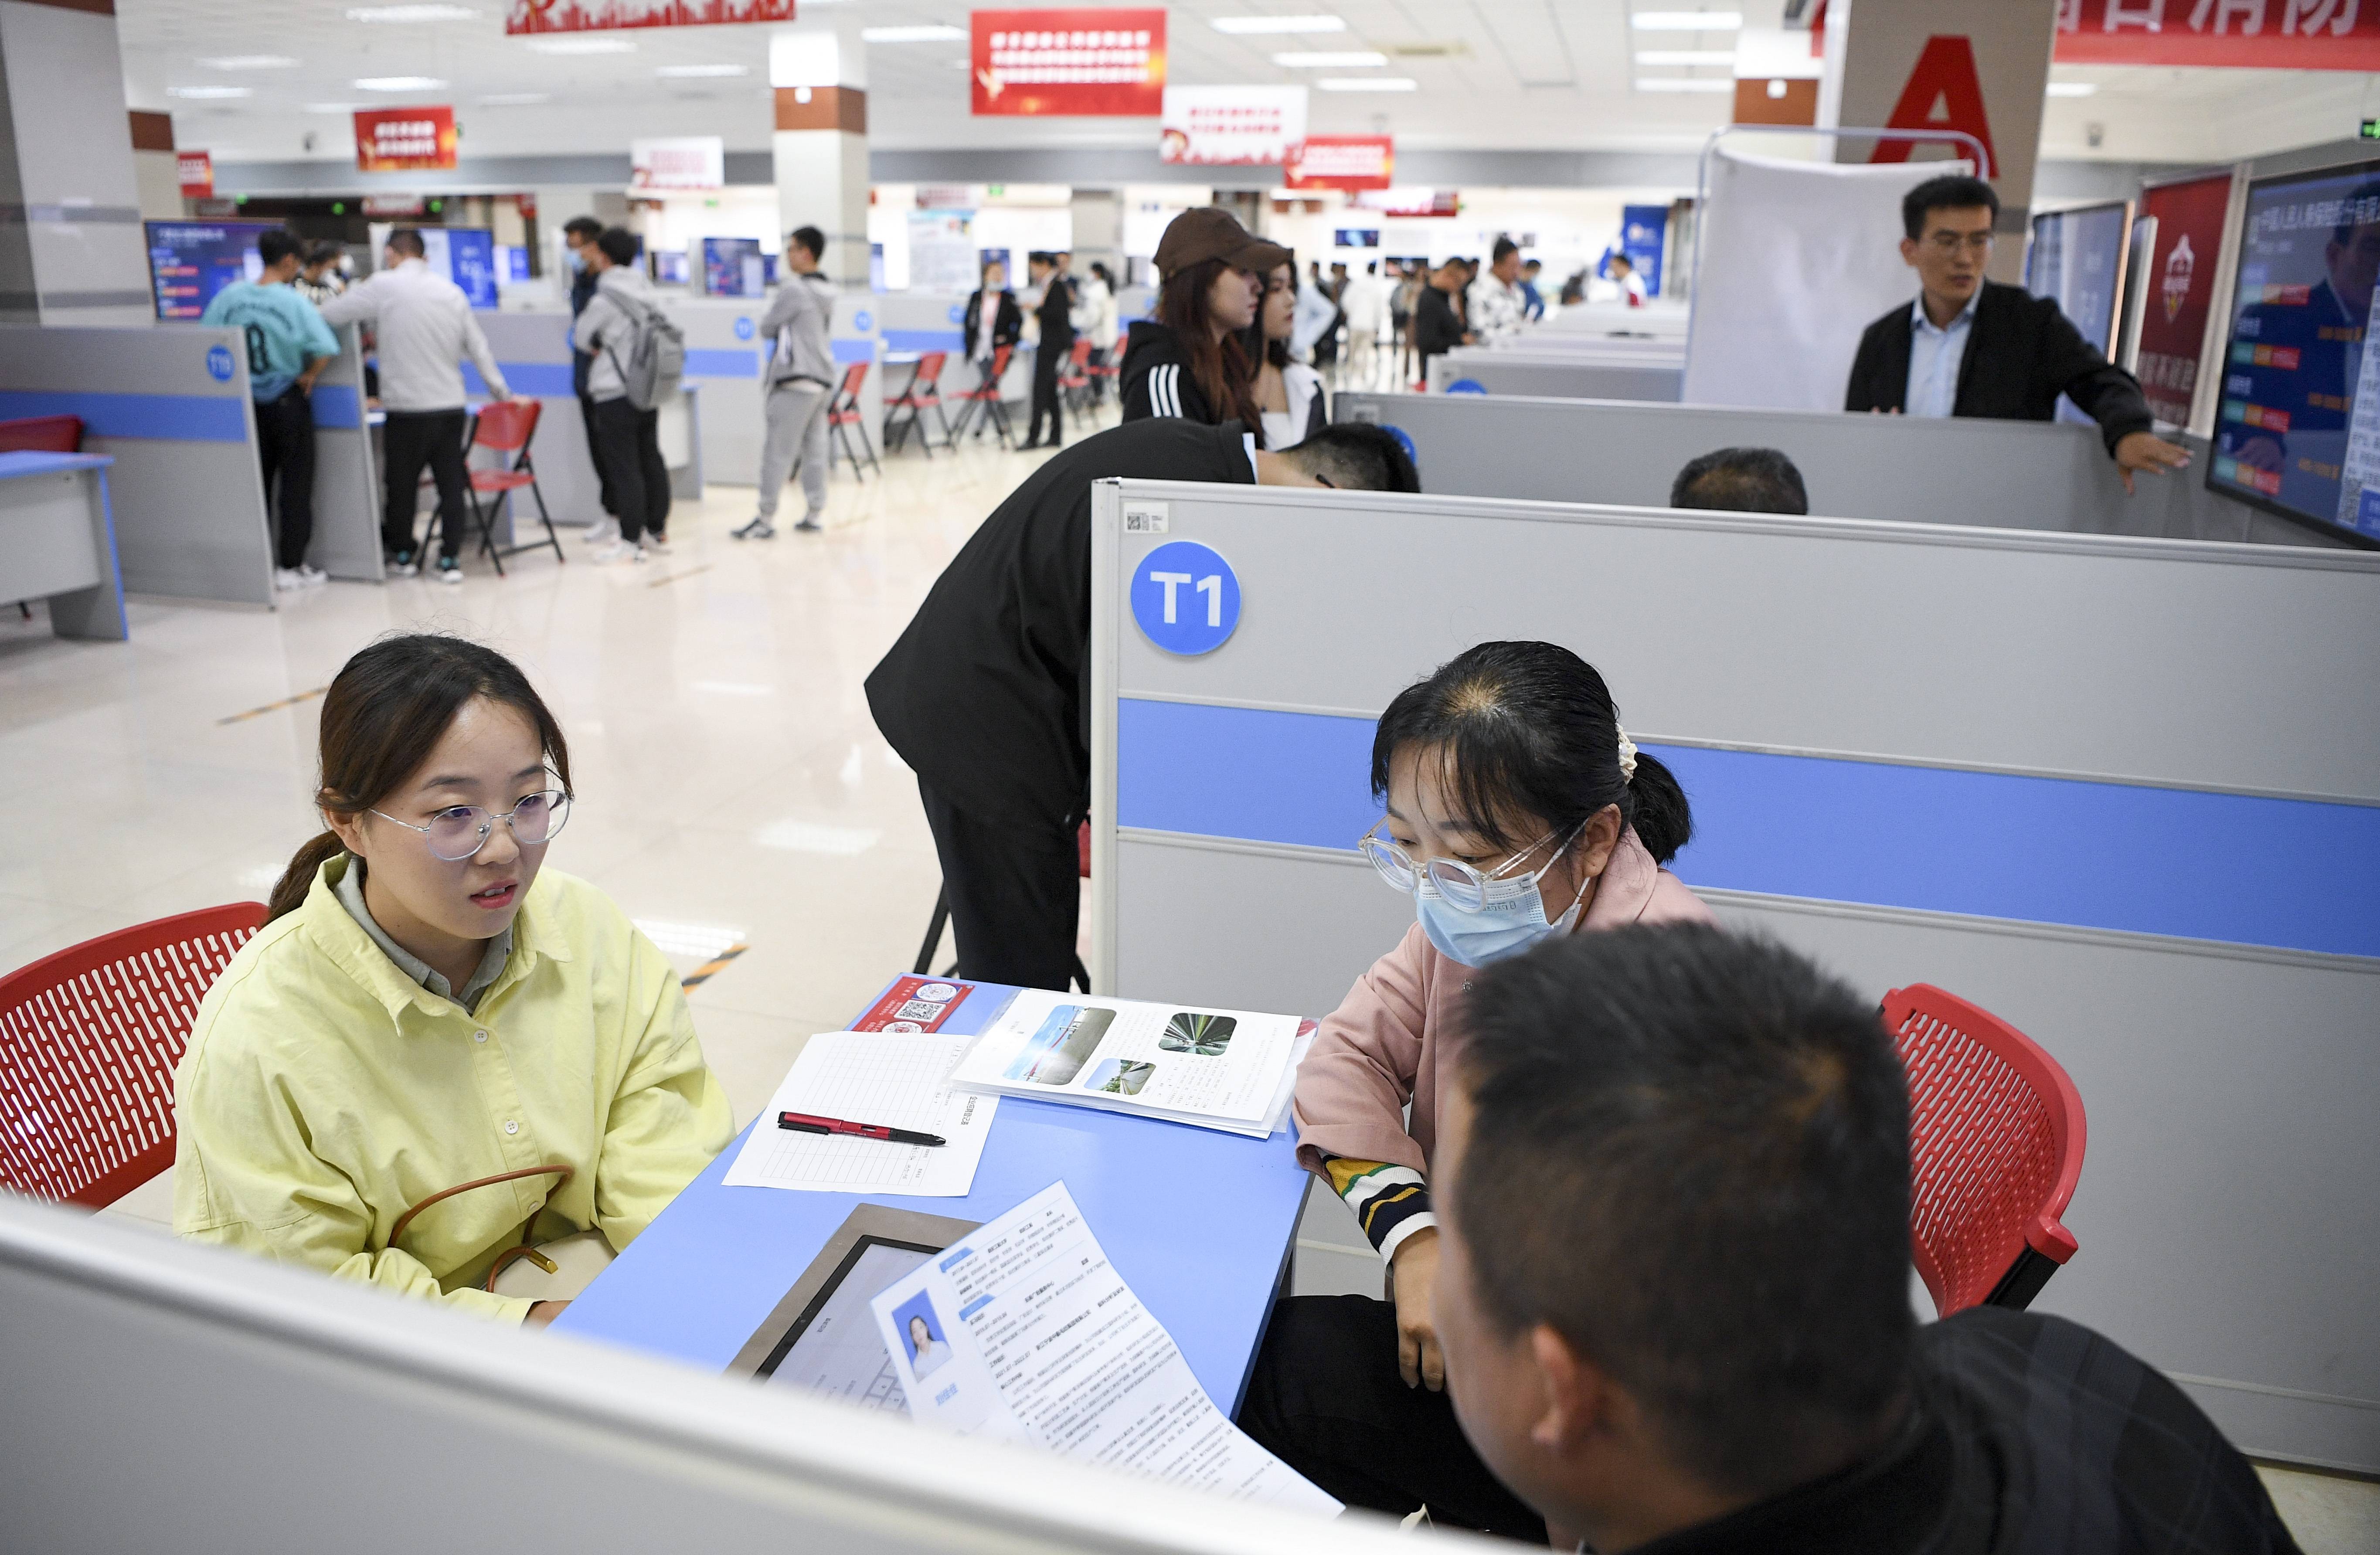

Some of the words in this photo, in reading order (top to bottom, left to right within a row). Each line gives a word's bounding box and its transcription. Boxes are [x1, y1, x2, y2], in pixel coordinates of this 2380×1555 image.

[1870, 35, 2000, 179] A
[1150, 571, 1222, 627] T1
[960, 1096, 977, 1126] 企业招聘登记表
